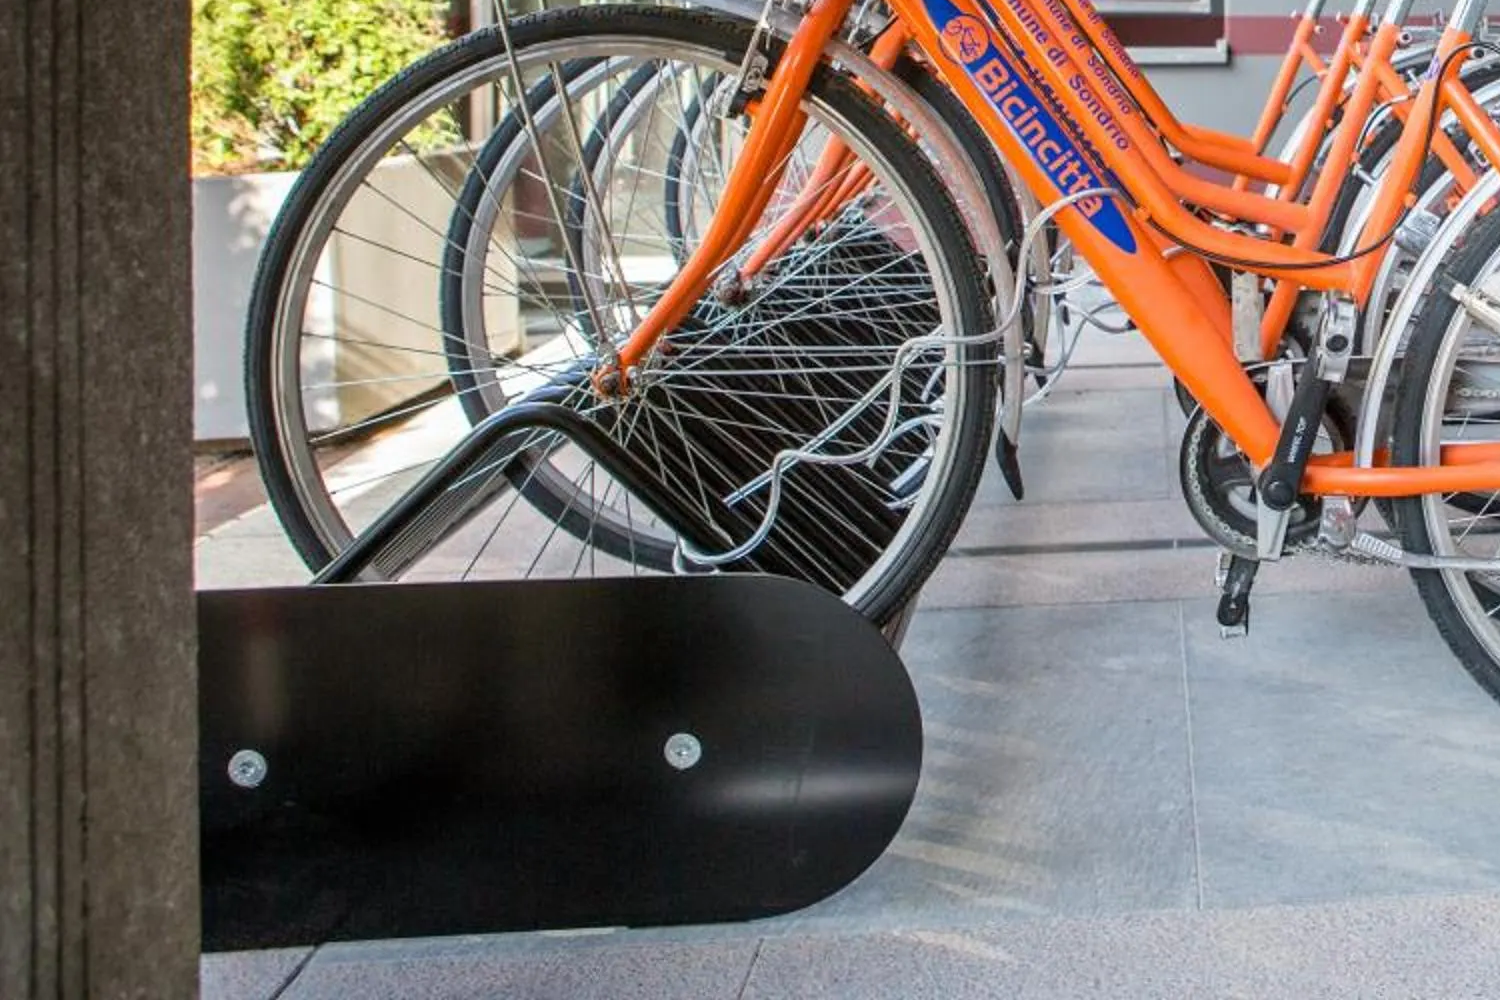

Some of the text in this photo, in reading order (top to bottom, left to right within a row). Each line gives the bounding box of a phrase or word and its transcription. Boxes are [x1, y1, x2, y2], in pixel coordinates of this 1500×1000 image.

[1047, 46, 1069, 68] di
[1069, 74, 1130, 150] Sondrio
[1071, 34, 1088, 51] di
[1088, 54, 1131, 115] Sondrio
